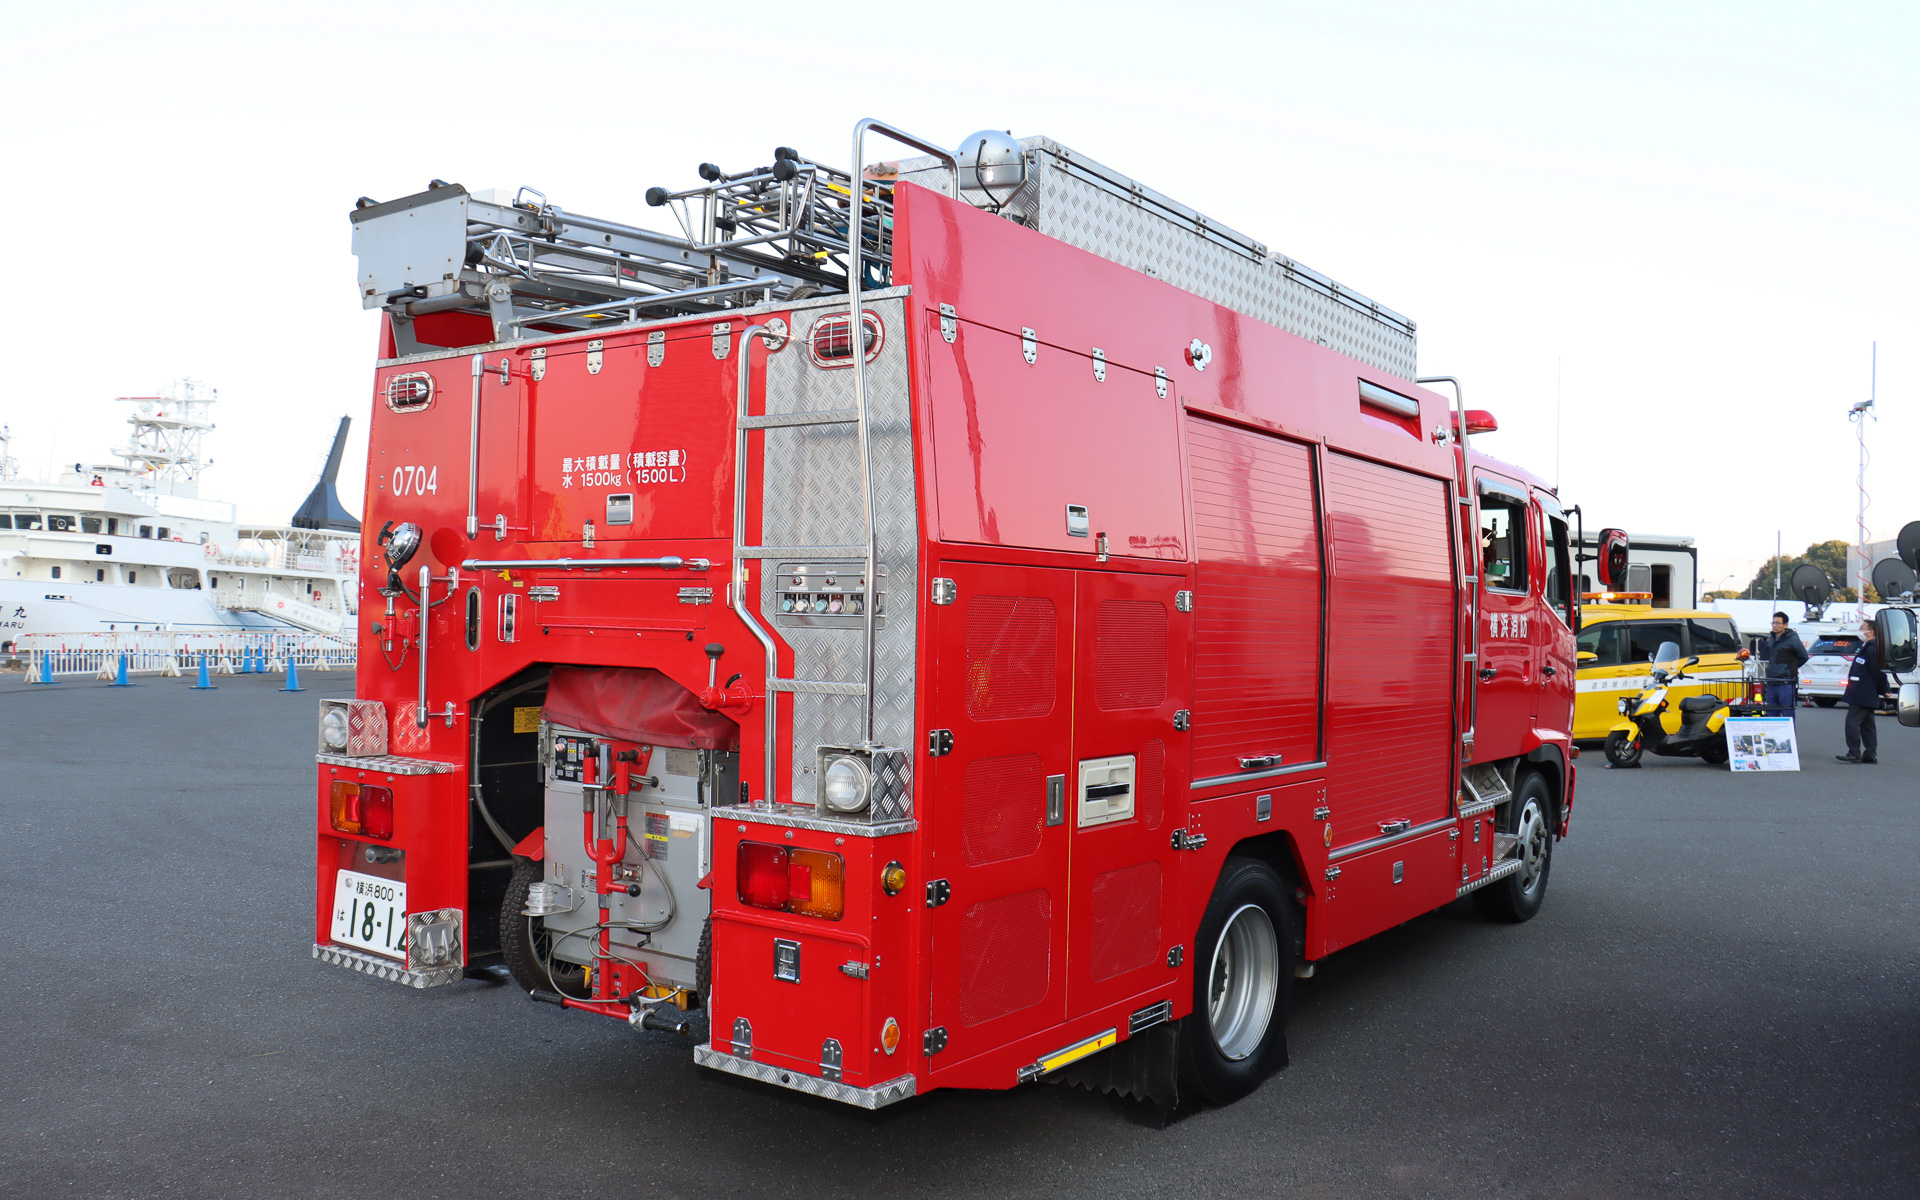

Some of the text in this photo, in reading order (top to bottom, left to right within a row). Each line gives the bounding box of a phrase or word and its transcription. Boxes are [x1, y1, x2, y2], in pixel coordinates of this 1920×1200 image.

[392, 465, 438, 497] 0704
[562, 474, 573, 489] 水
[580, 472, 622, 487] 1500kg
[1489, 612, 1528, 639] 横浜消防
[336, 909, 346, 922] は
